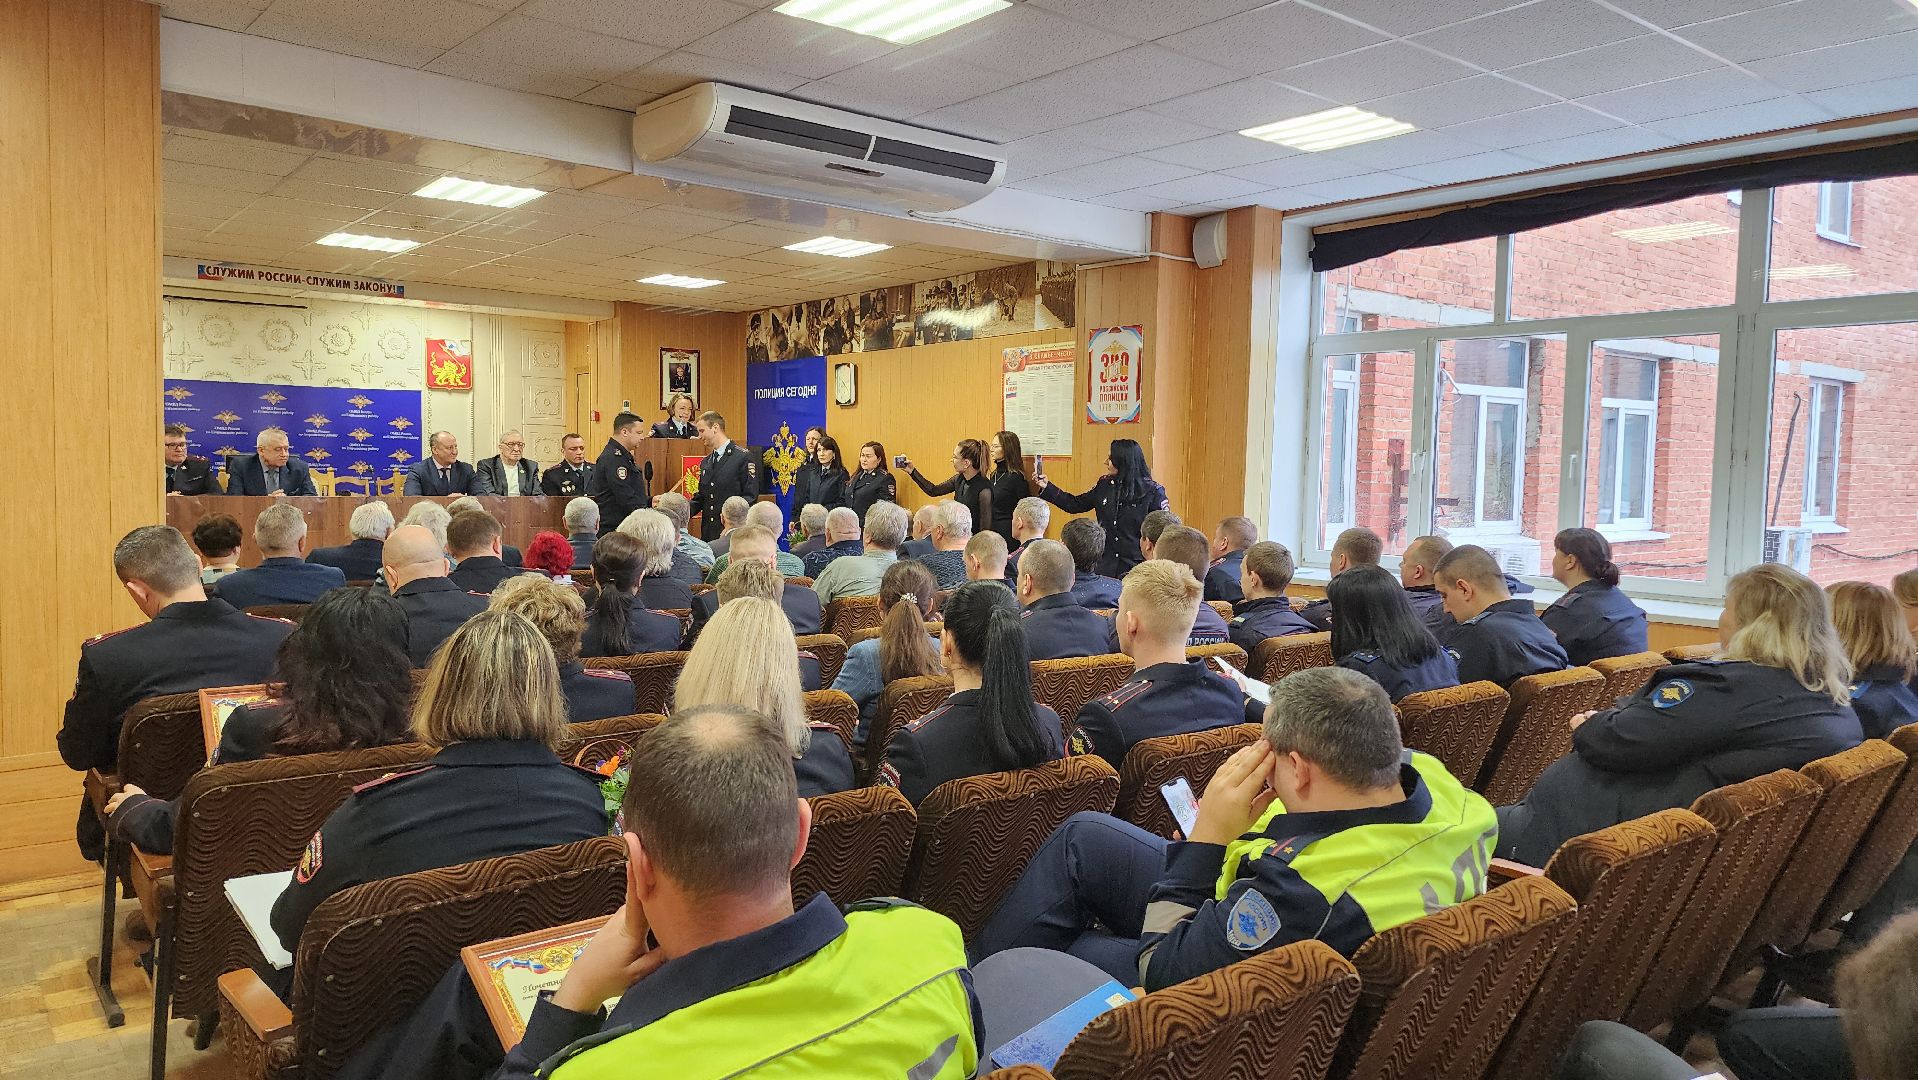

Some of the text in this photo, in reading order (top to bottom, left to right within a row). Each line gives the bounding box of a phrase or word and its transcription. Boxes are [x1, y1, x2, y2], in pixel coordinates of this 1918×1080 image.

[206, 265, 254, 279] СЛУЖИМ
[353, 280, 396, 294] ЗАКОНУ!
[754, 385, 817, 400] ПОЛИЦИЯ СЕГОДНЯ
[1099, 392, 1128, 402] ПОЛИЦИИ
[522, 979, 563, 994] Почетна
